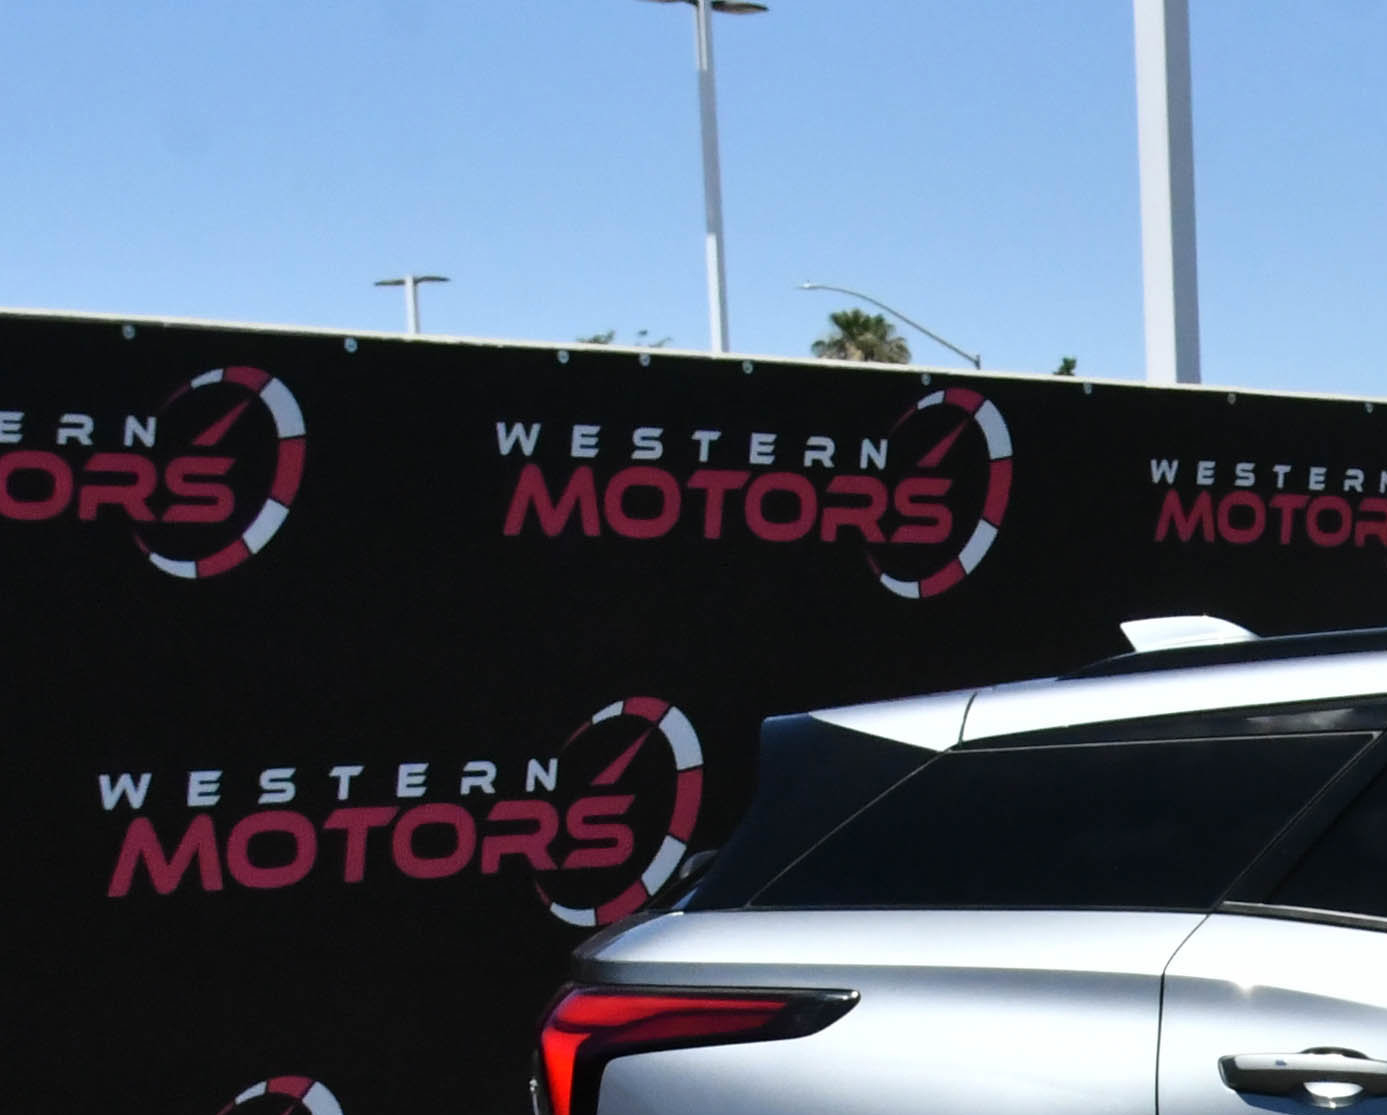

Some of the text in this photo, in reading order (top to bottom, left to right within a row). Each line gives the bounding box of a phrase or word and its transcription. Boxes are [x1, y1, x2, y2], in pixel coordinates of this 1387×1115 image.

[496, 421, 889, 470] WESTERN
[503, 464, 955, 544] MOTORS
[99, 757, 559, 811] WESTERN
[107, 793, 636, 898] MOTORS
